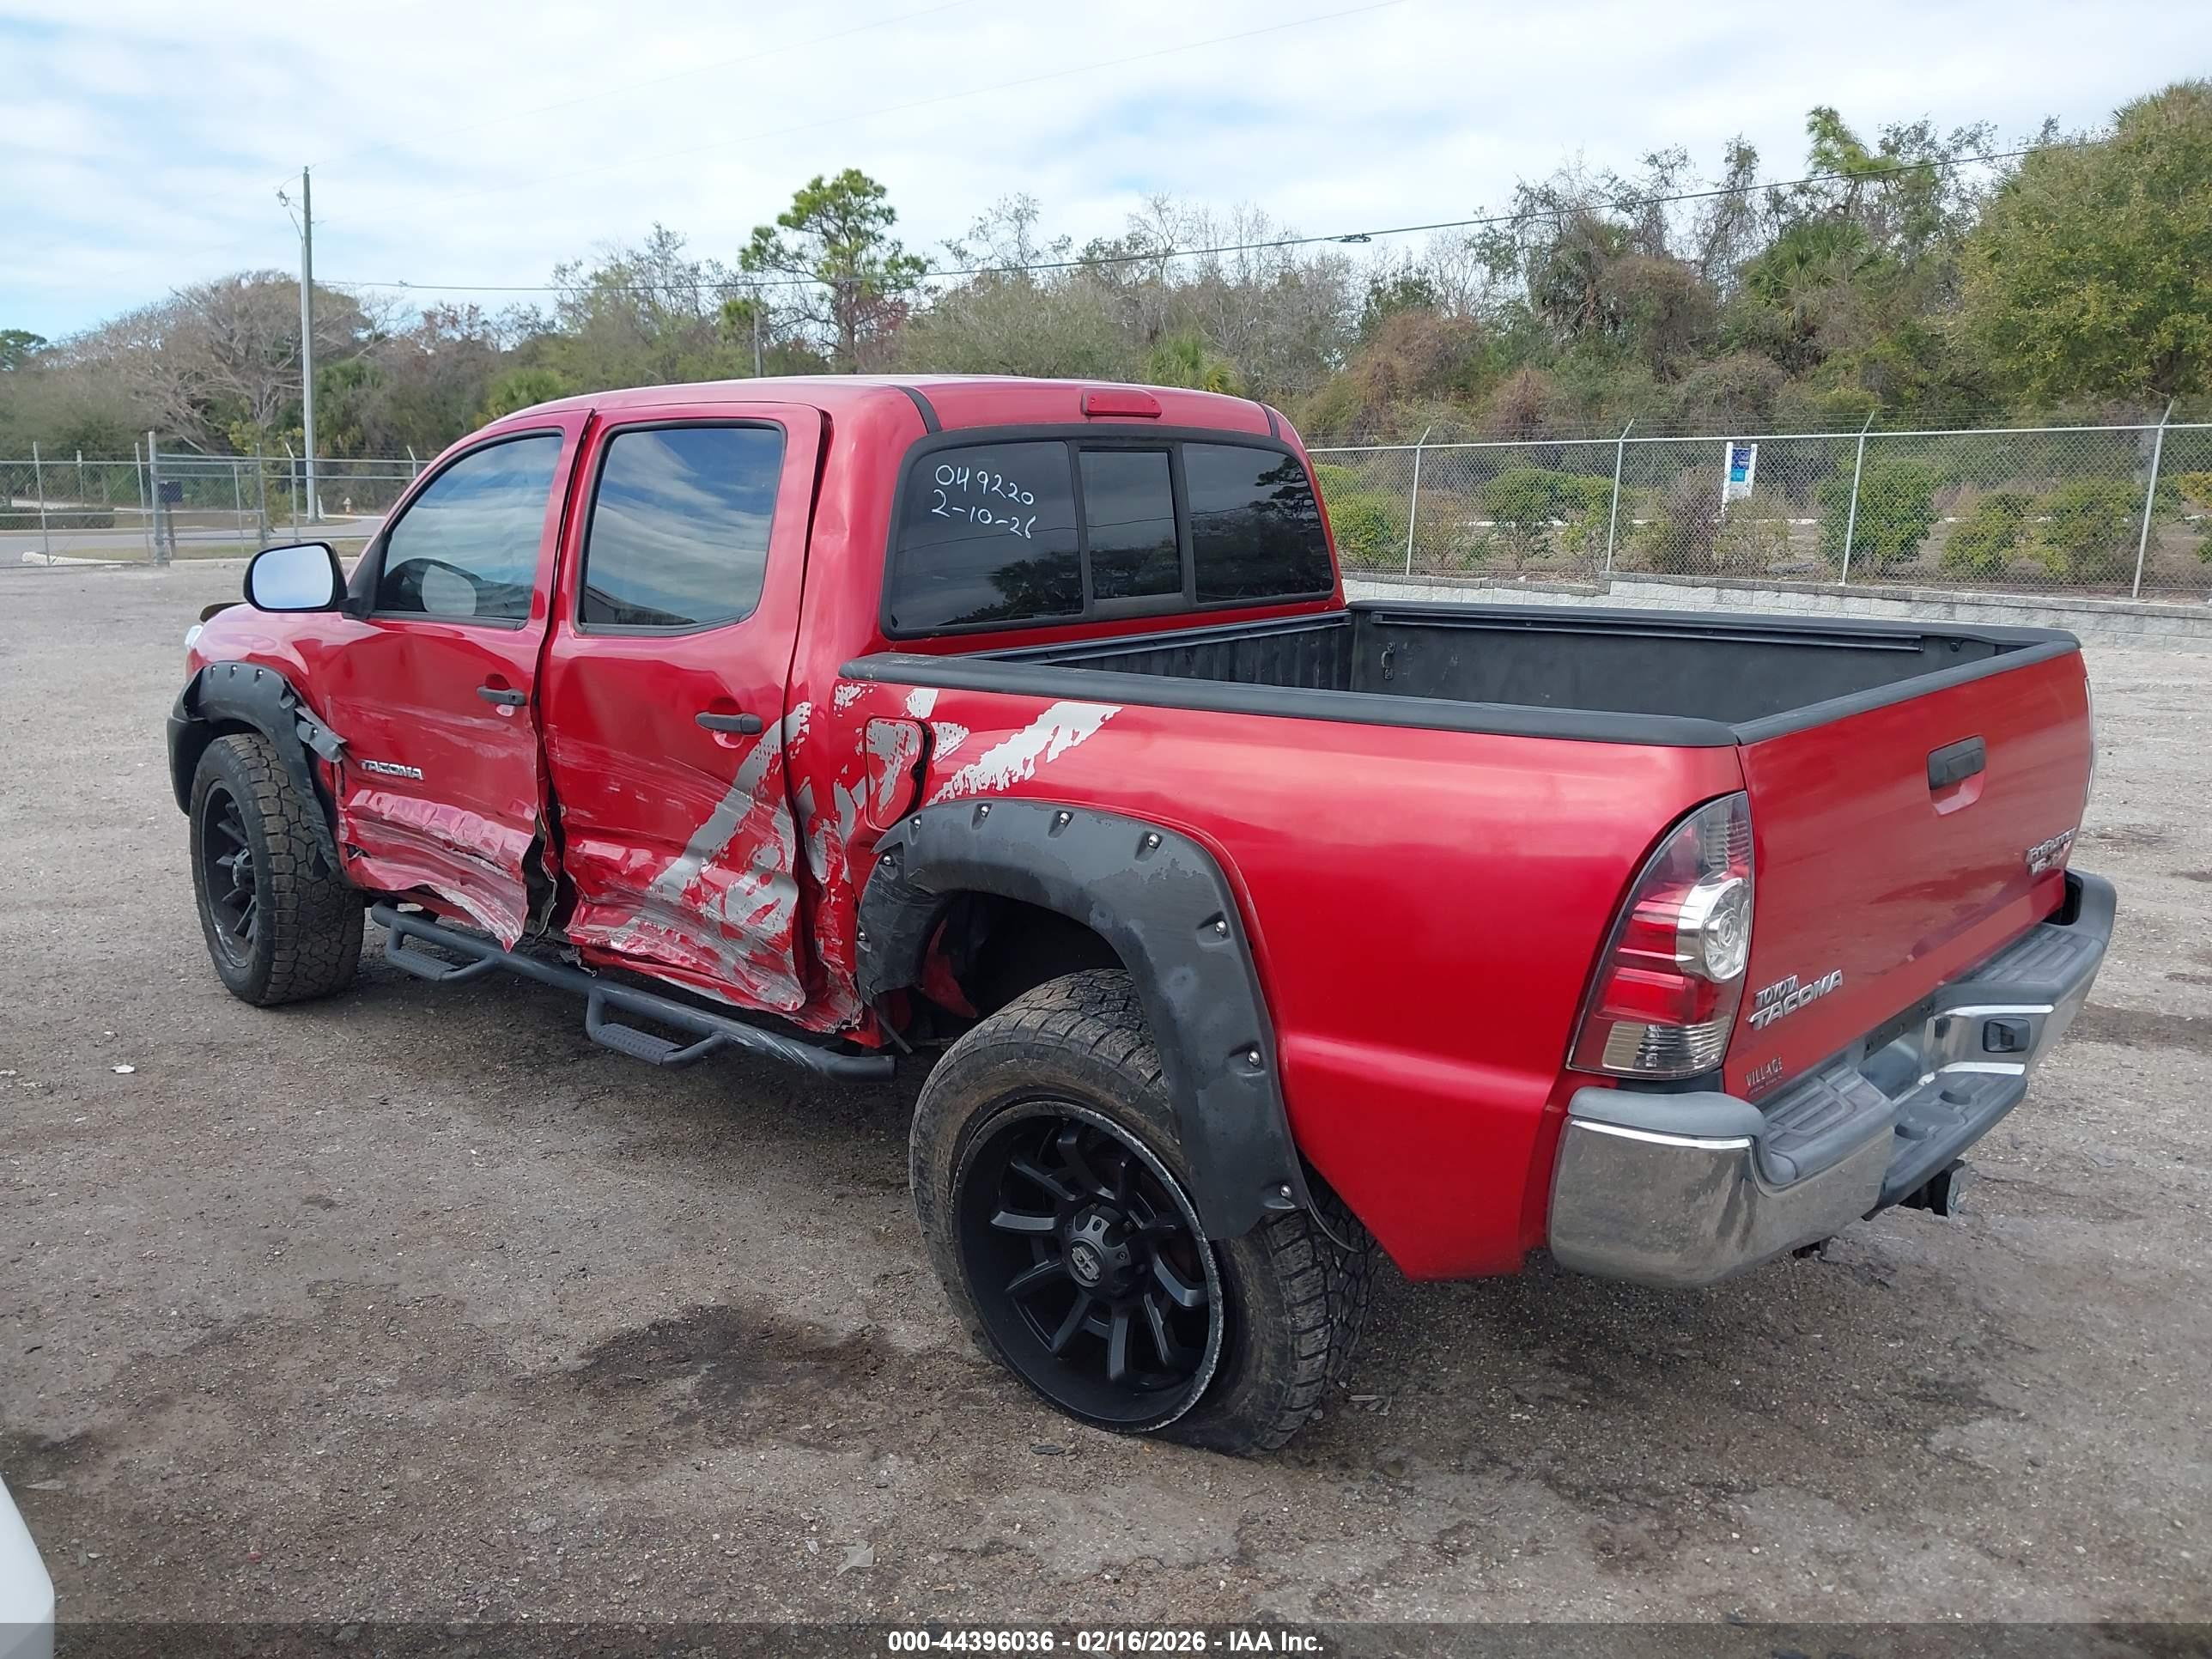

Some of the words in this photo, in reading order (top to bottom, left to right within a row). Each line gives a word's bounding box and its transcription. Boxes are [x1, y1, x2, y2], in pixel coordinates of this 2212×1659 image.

[931, 489, 1036, 538] 2-10-26
[362, 759, 424, 780] TACOMA
[1748, 969, 1844, 1030] TACOMA
[1755, 975, 1800, 1007] TOYOTA
[1746, 1057, 1783, 1086] VILLAGE
